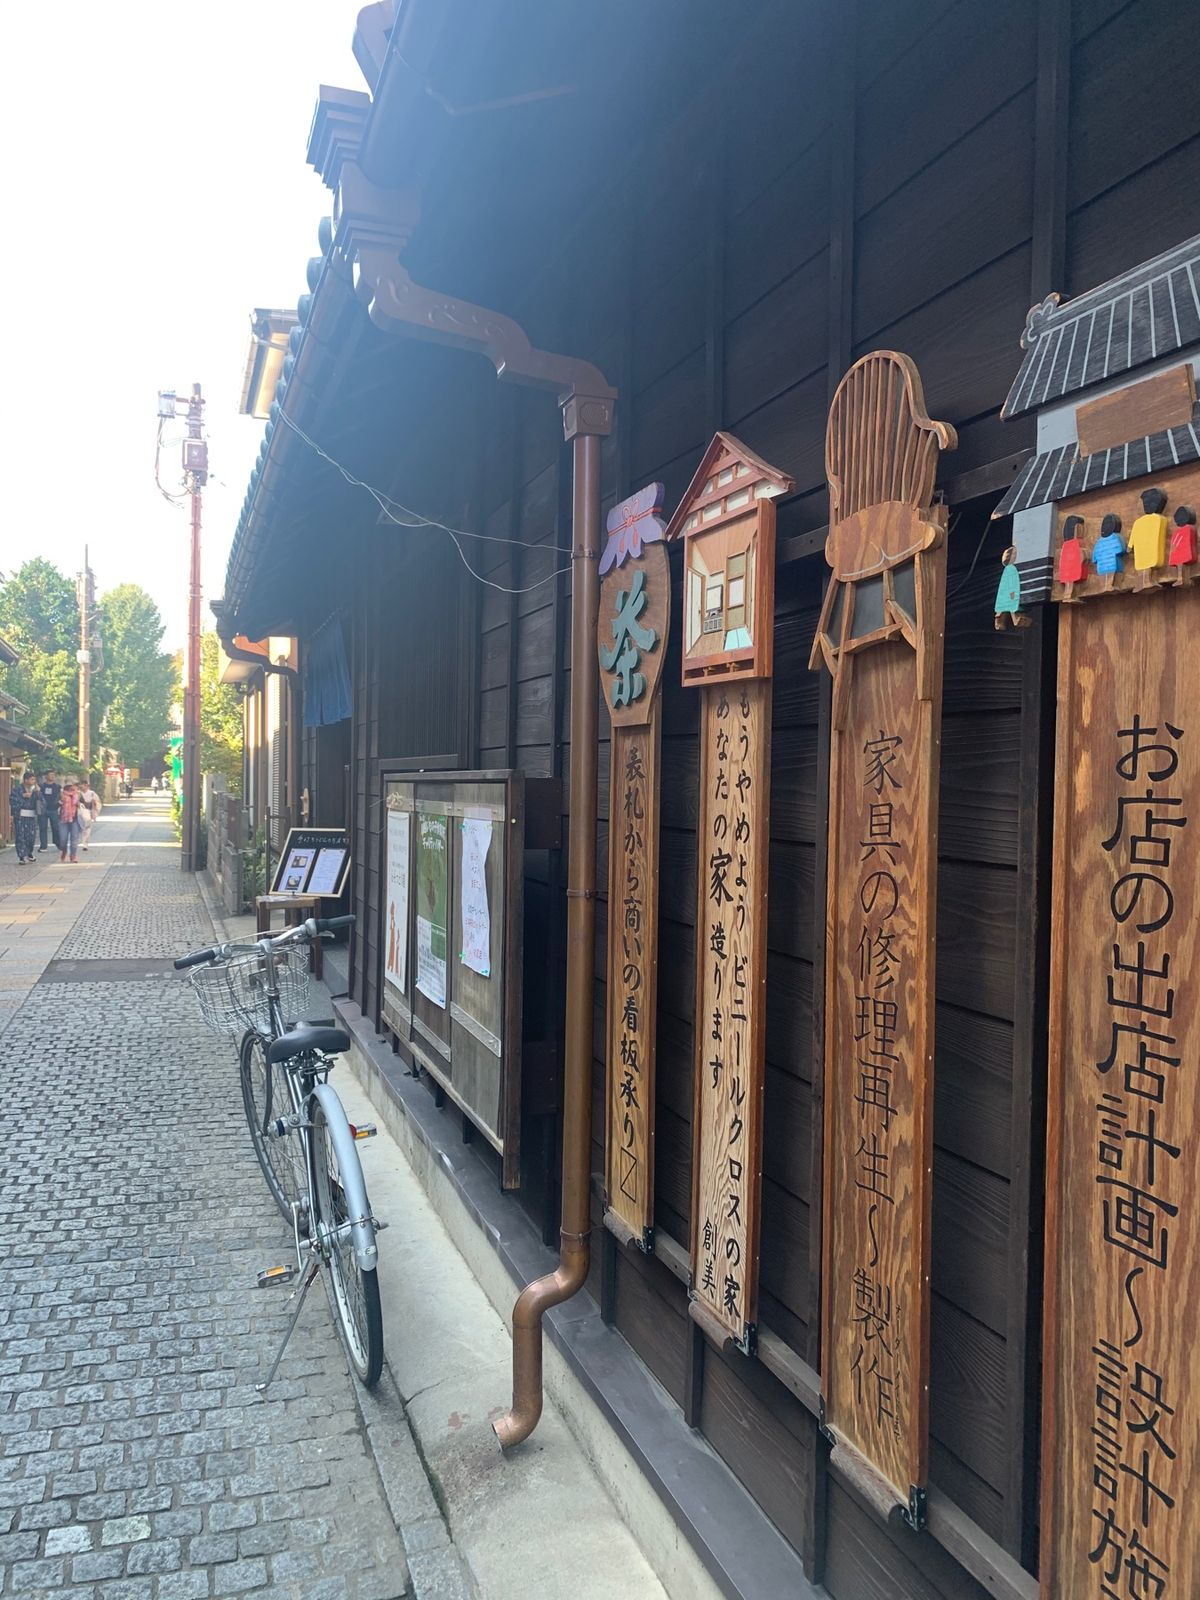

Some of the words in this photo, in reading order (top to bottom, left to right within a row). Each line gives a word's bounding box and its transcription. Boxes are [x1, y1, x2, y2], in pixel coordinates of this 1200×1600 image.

[600, 570, 656, 710] 茶
[1088, 714, 1188, 1600] お店の出店計画〜設計施
